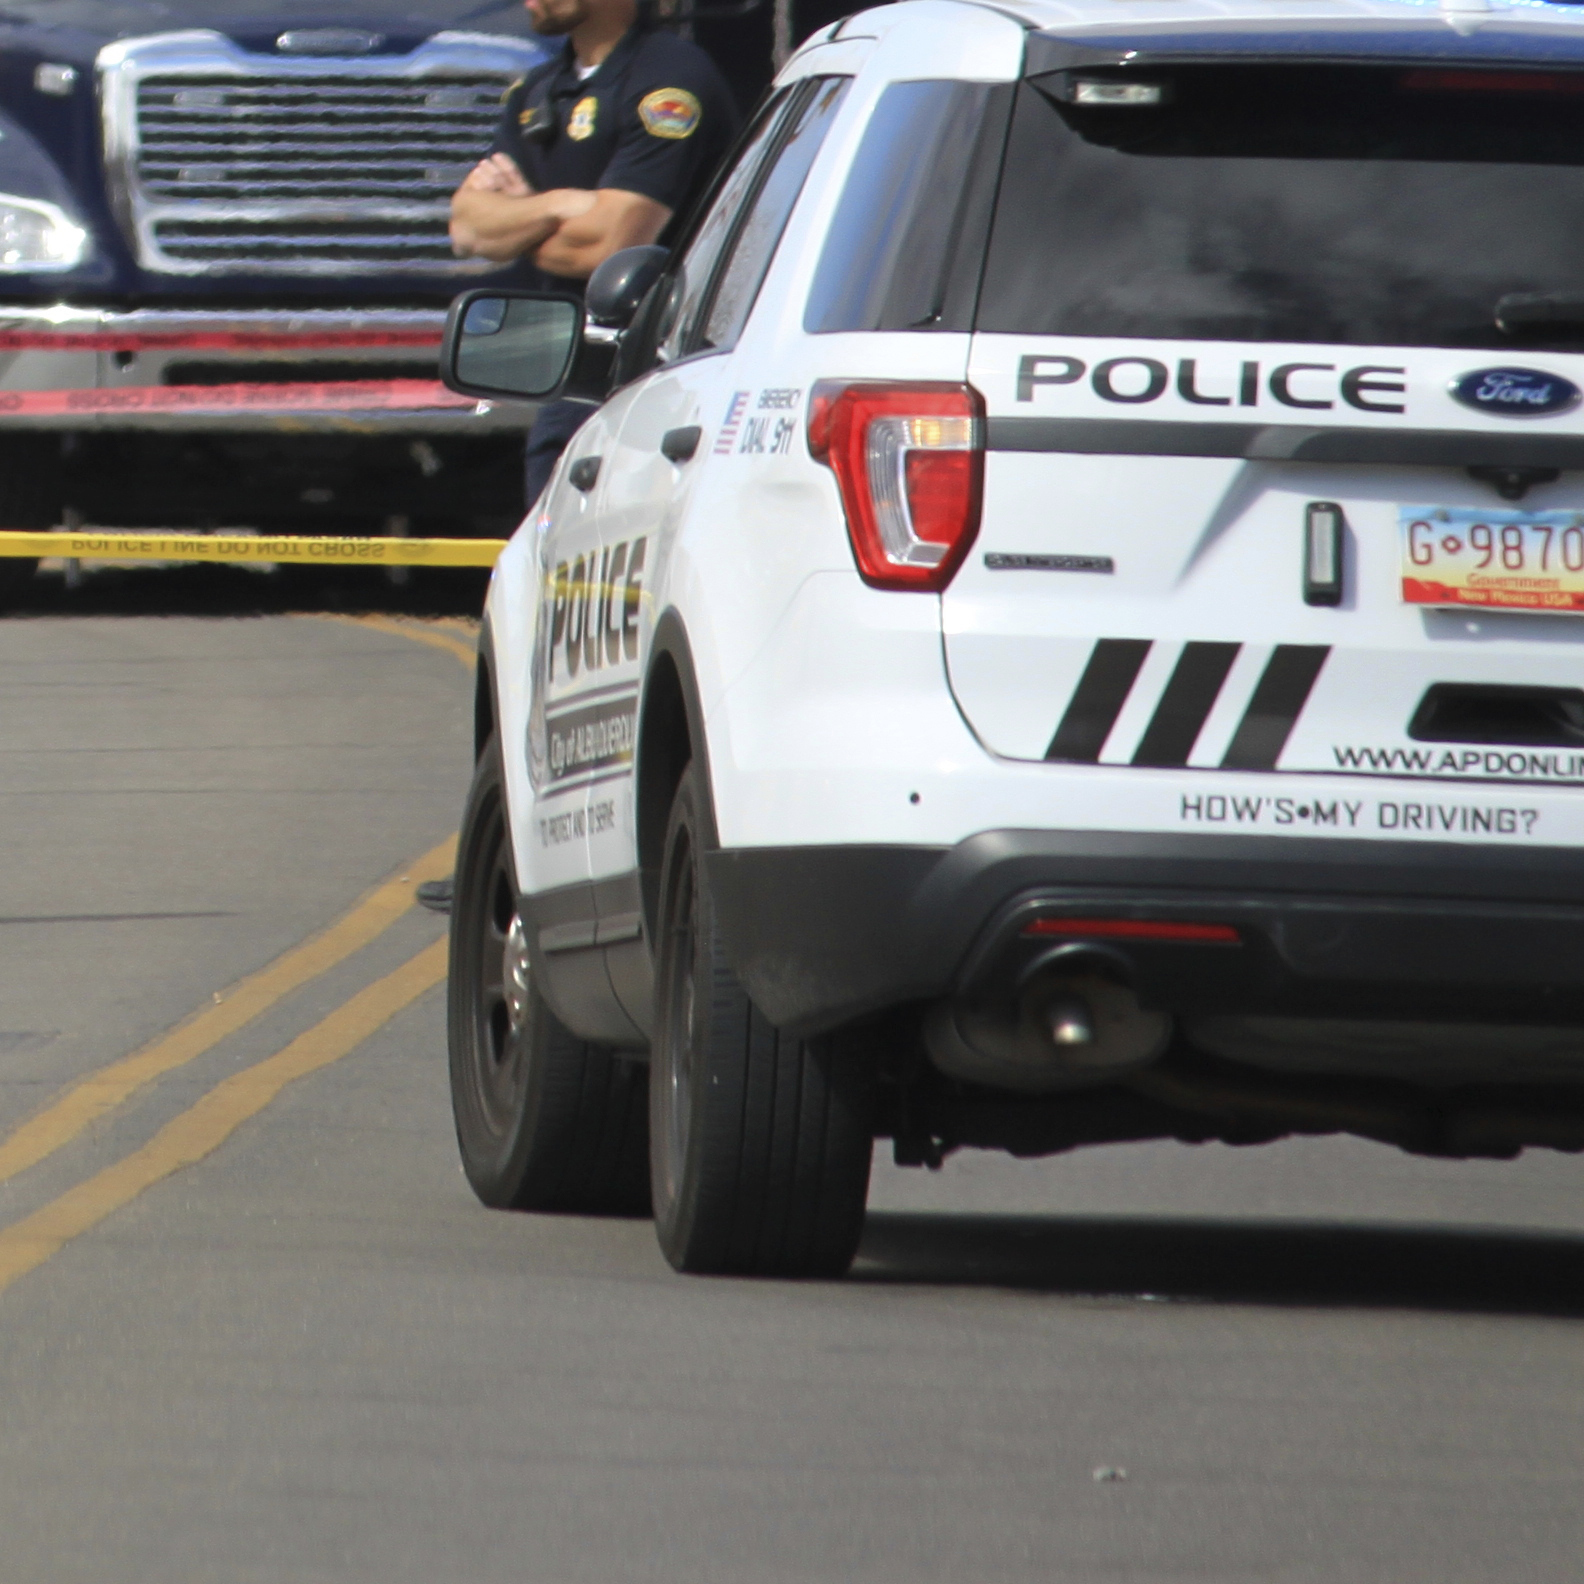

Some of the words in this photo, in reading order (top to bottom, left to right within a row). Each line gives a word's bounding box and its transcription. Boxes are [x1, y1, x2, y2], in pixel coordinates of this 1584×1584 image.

[1016, 353, 1406, 414] POLICE
[1475, 372, 1554, 406] Ford
[548, 537, 648, 684] POLICE
[1458, 588, 1488, 601] New
[1490, 590, 1539, 605] Mexico
[1543, 593, 1574, 607] USA
[550, 732, 566, 776] City
[1378, 803, 1539, 834] DRIVING?
